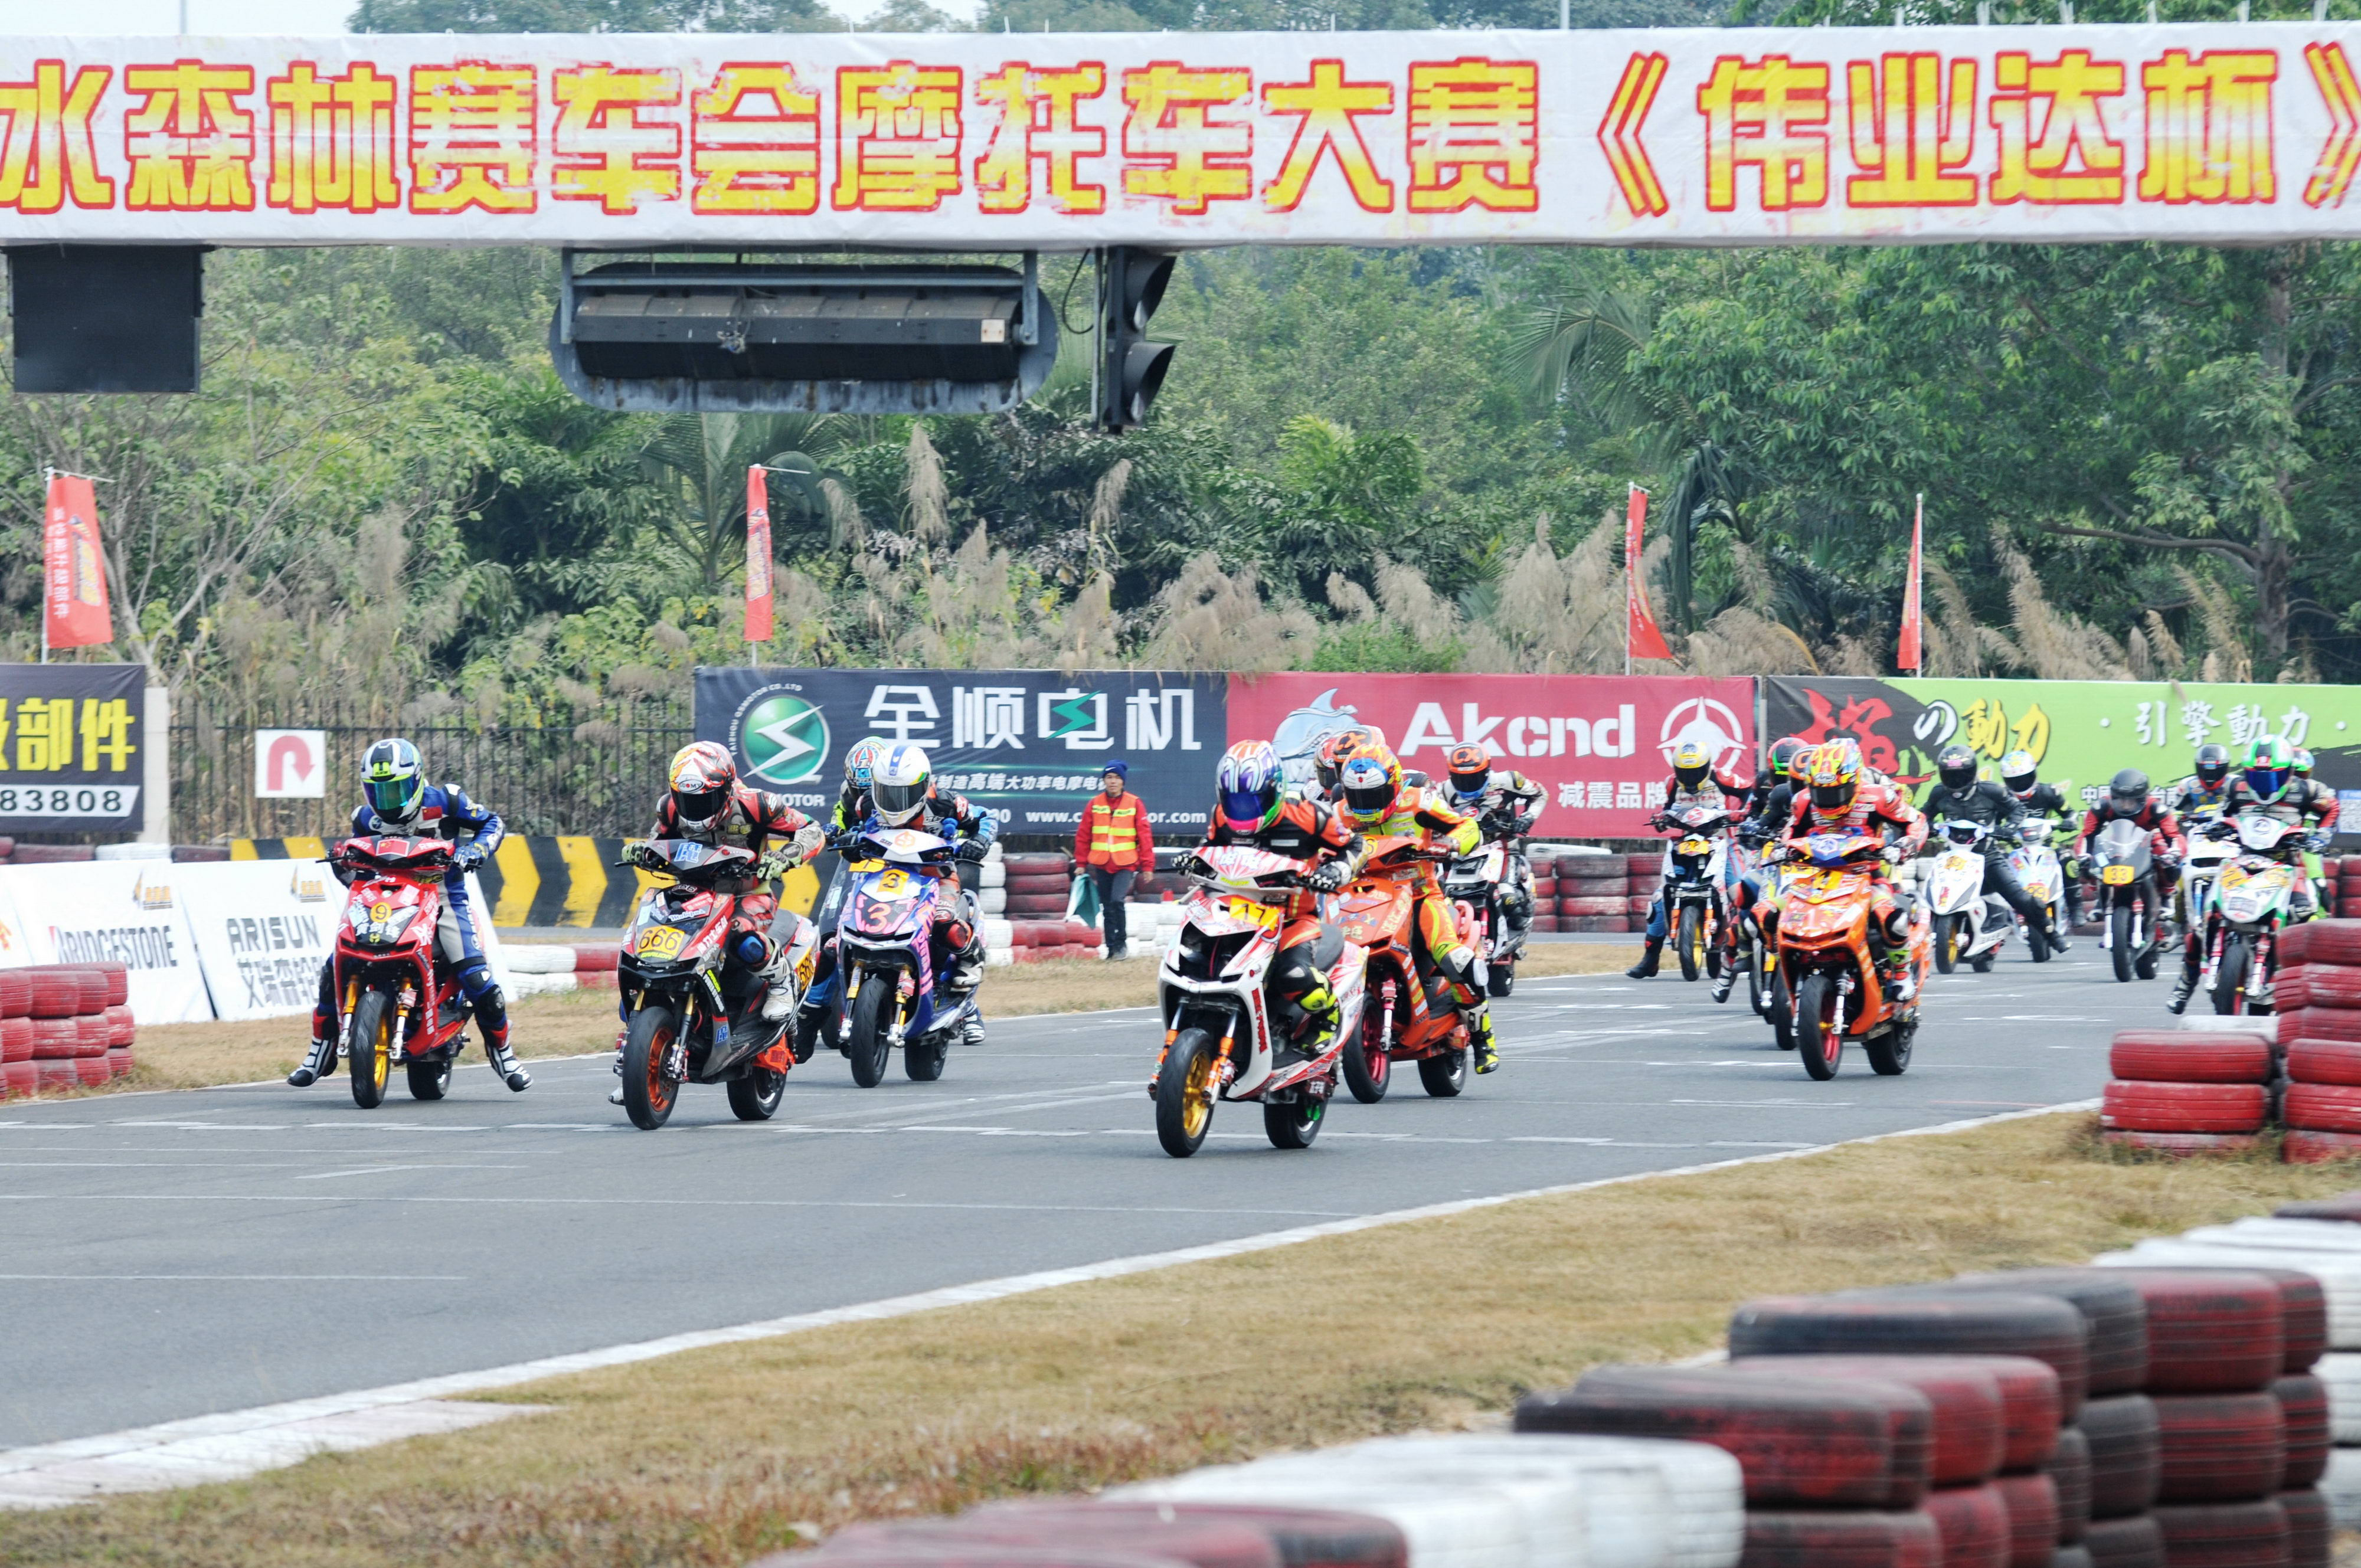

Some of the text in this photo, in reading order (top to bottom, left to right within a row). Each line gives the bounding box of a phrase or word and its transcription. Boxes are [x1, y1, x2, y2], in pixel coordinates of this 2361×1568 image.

[864, 685, 1202, 750] 全顺电机
[2135, 700, 2310, 748] 引擎動力
[0, 790, 122, 812] 83808
[776, 793, 826, 807] OTOR
[1558, 781, 1668, 808] 减震品牌
[882, 873, 900, 888] 3
[2111, 868, 2127, 881] 33
[376, 904, 387, 919] 9
[865, 902, 891, 933] 3
[1240, 904, 1266, 922] 17
[227, 915, 321, 955] ARISUN
[639, 928, 681, 951] 666
[48, 925, 177, 970] BRIDGESTONE
